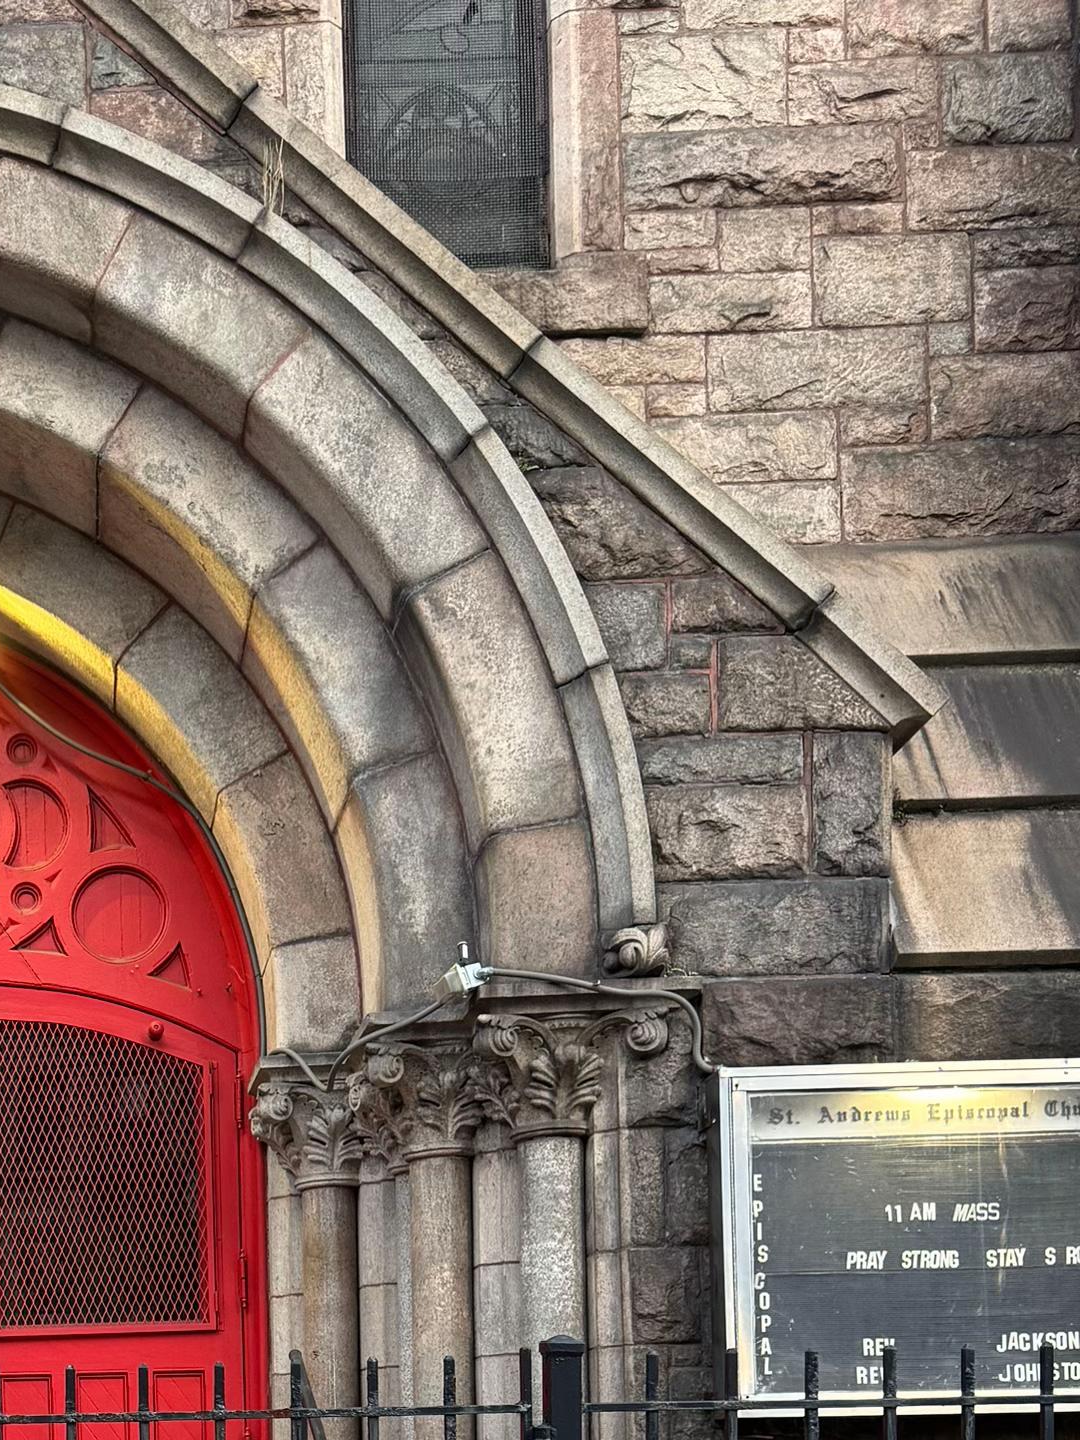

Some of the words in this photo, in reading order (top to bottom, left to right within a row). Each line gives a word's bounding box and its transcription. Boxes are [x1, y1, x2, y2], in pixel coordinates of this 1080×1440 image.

[766, 1106, 801, 1126] St.
[817, 1105, 911, 1125] Andrews
[927, 1100, 1030, 1126] Episcopal
[884, 1203, 903, 1224] 11
[909, 1201, 937, 1222] AM
[952, 1201, 1001, 1223] MASS
[845, 1249, 888, 1270] PRAY
[901, 1248, 961, 1270] STRONG
[985, 1246, 1027, 1269] STAY
[996, 1330, 1080, 1353] JACKSON
[998, 1361, 1080, 1383] JOHSTO
